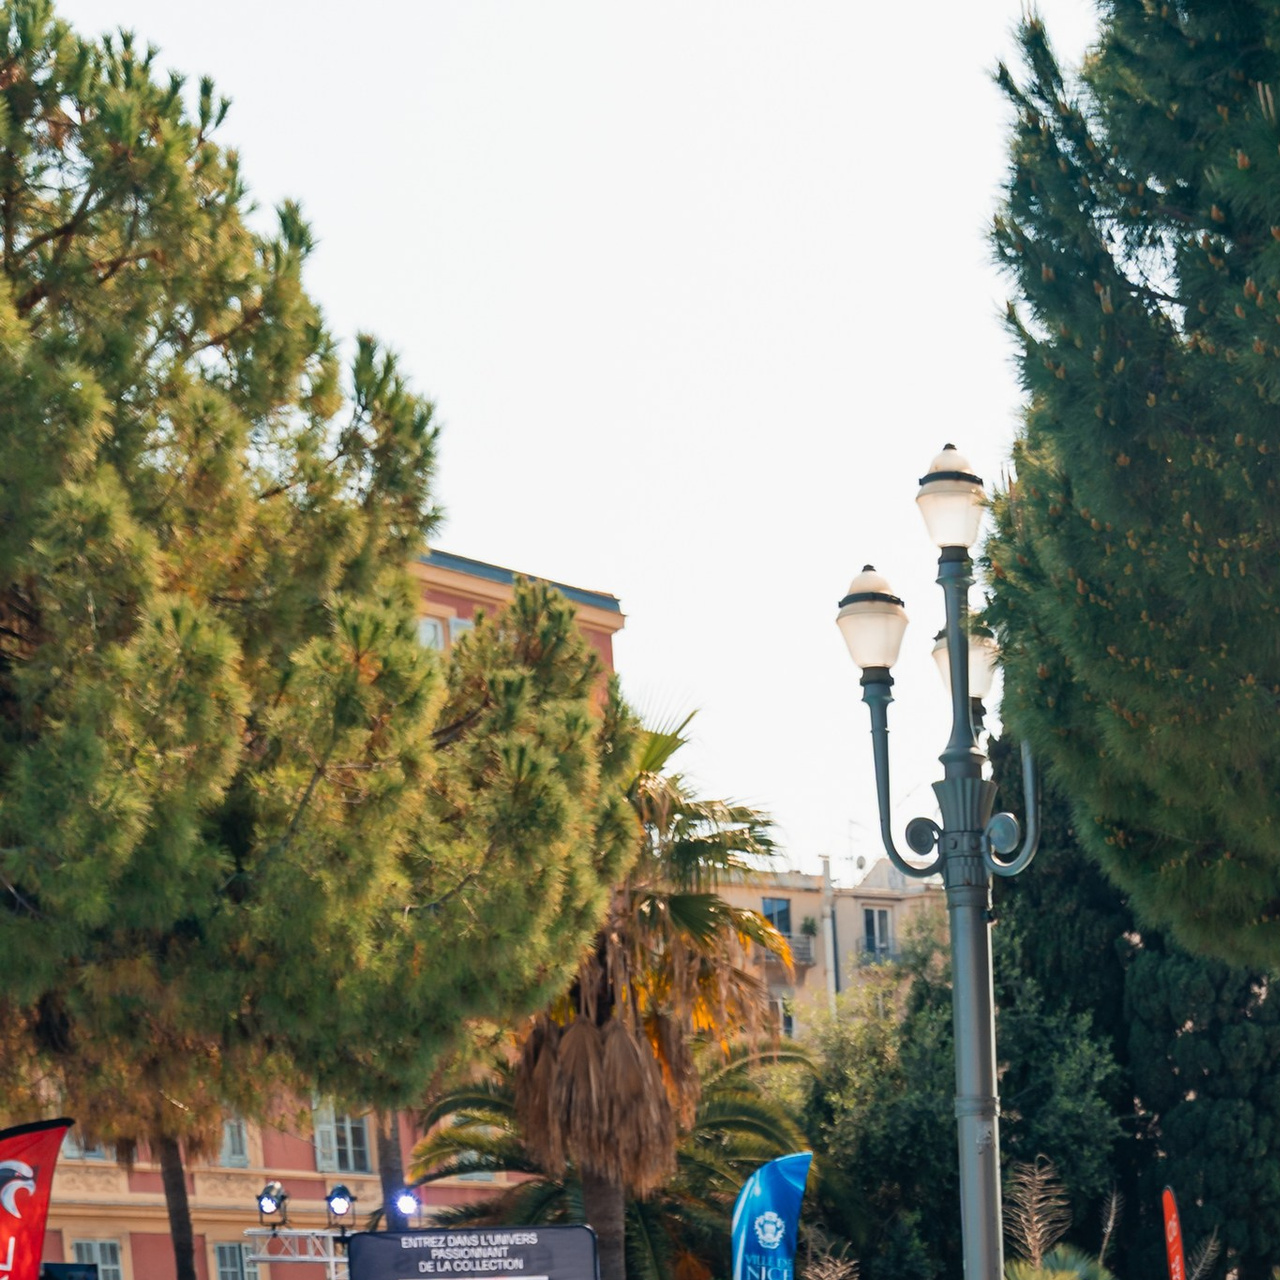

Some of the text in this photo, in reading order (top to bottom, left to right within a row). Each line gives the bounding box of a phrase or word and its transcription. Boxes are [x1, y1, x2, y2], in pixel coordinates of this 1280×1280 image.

[401, 1232, 538, 1249] ENTREZ DANS L'UNIVERS
[431, 1246, 509, 1260] PASSIONNANT
[418, 1258, 524, 1273] DE LA COLLECTION
[745, 1254, 775, 1267] VILLE
